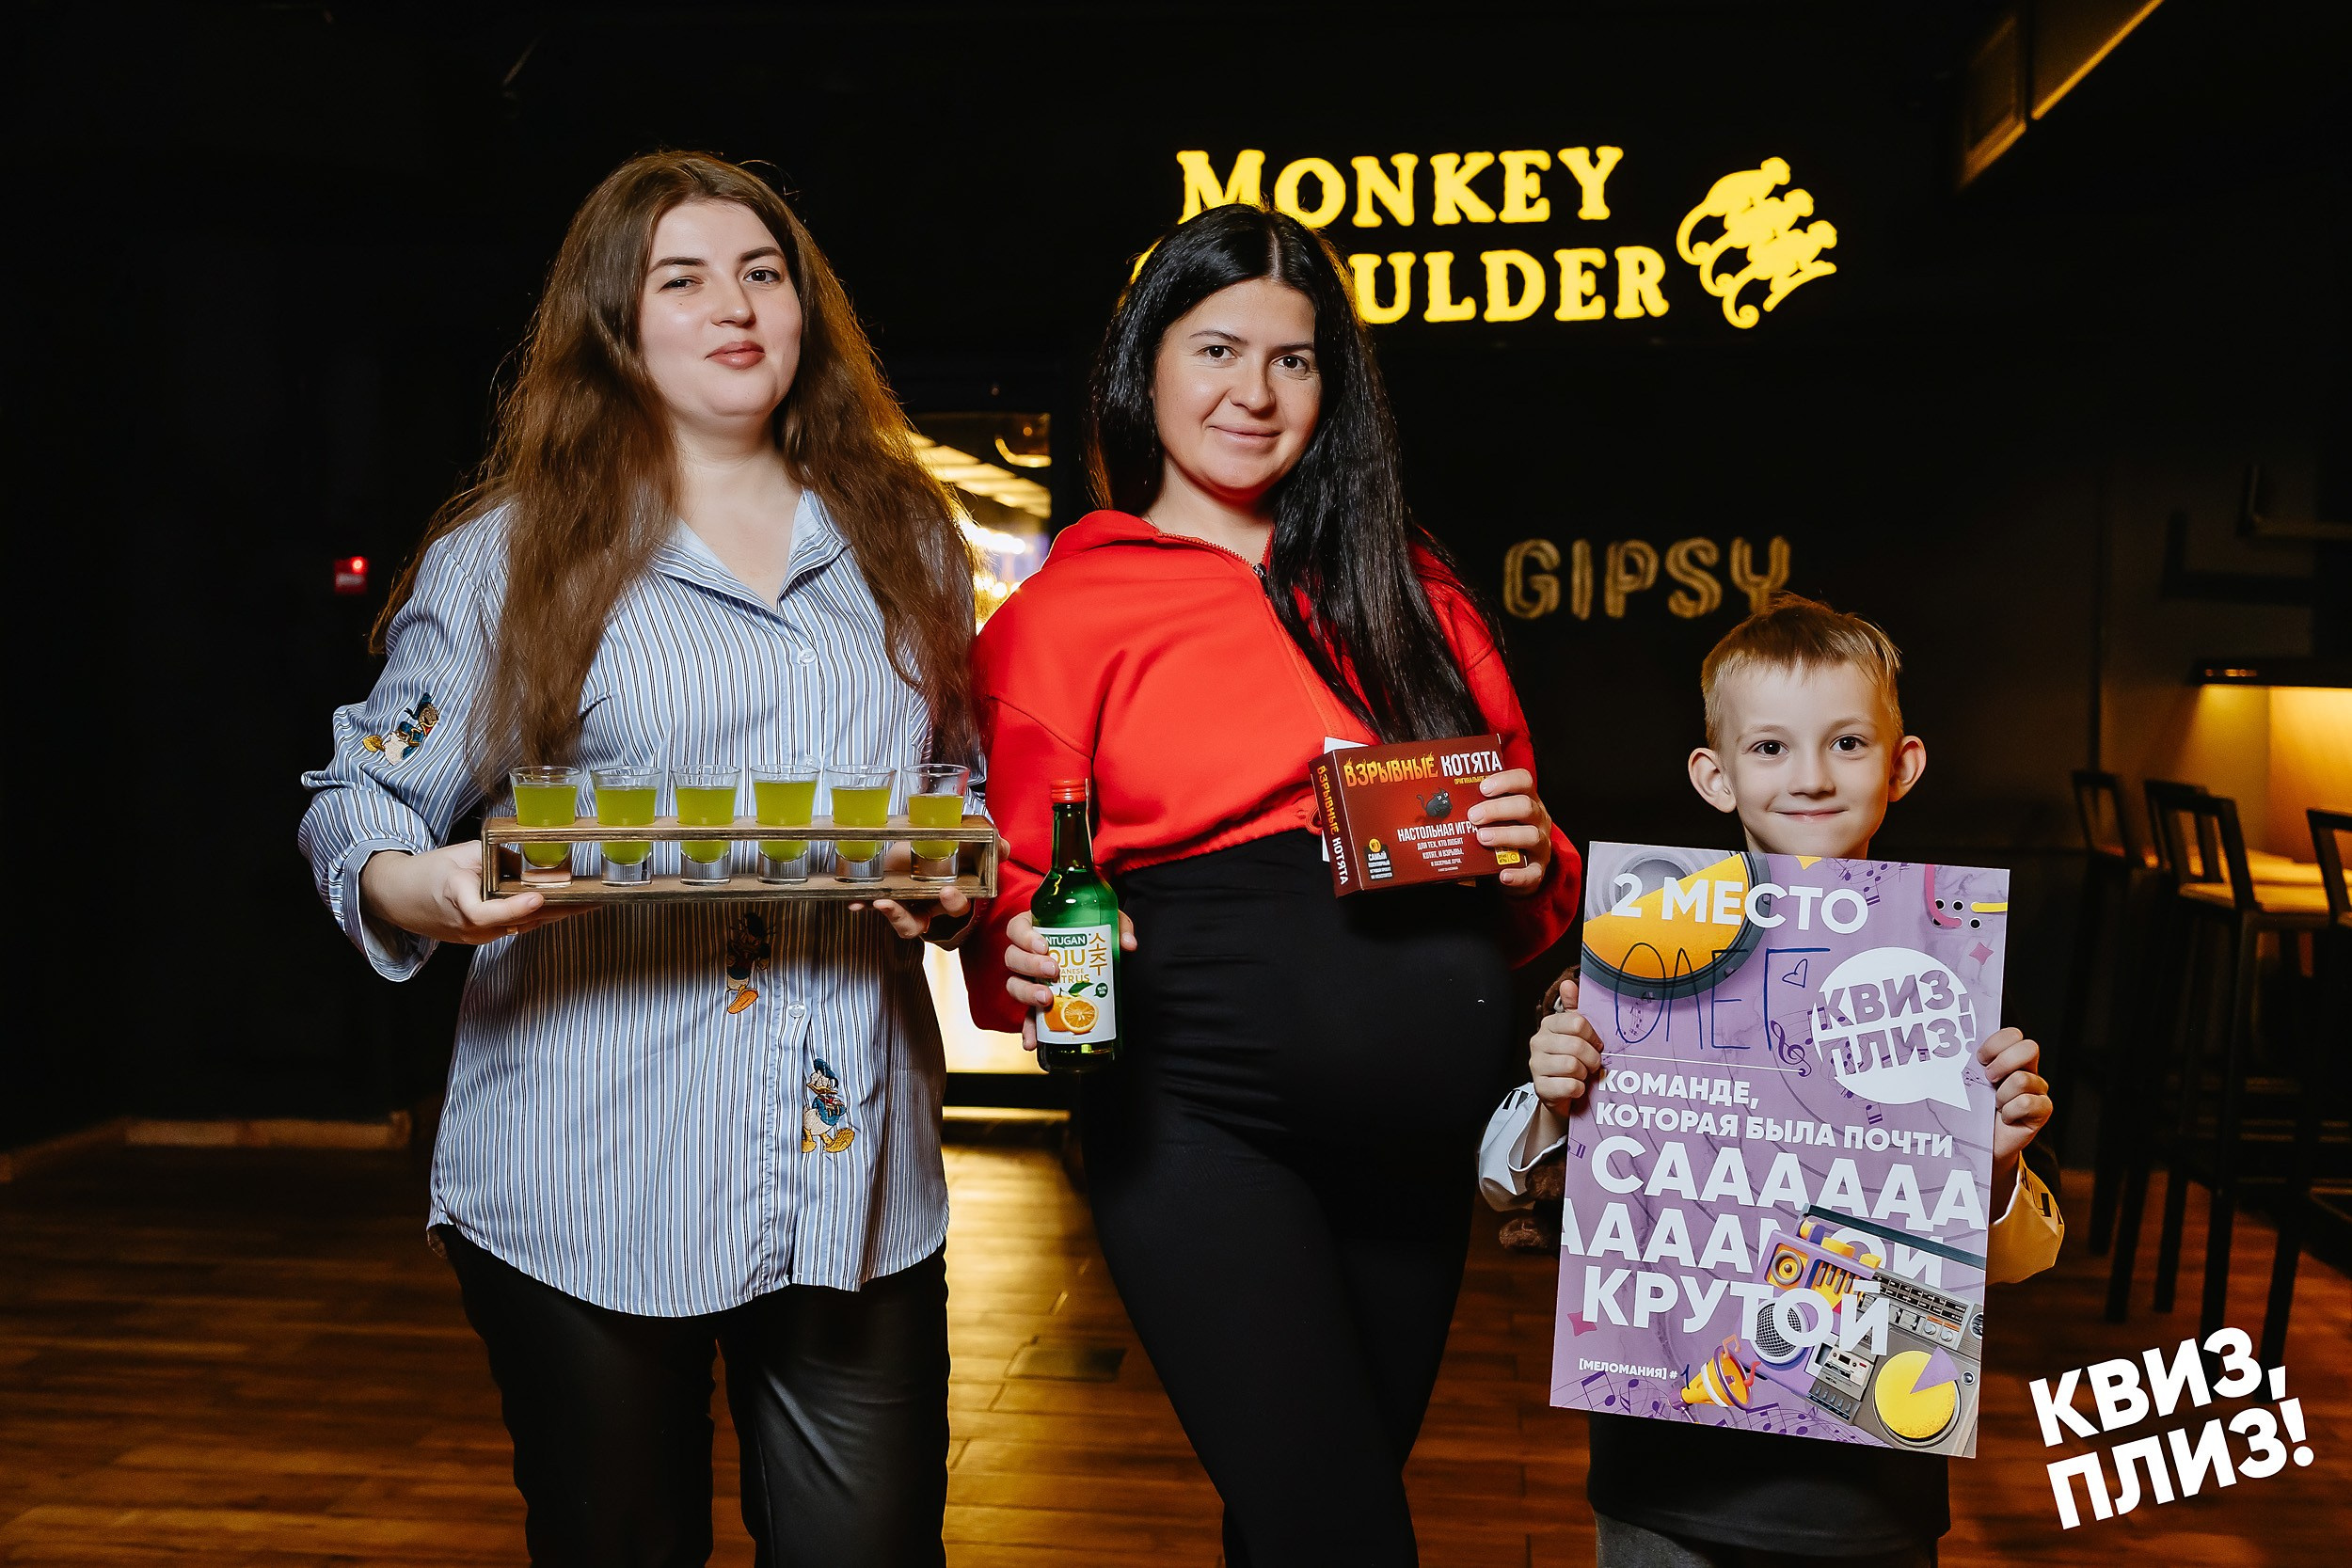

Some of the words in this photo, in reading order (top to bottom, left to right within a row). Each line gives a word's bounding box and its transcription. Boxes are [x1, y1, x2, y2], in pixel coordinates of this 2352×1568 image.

[1176, 145, 1624, 228] MONKEY
[1128, 243, 1670, 325] ULDER
[1504, 535, 1792, 620] GIPSY
[1343, 752, 1438, 787] ВЗРЫВНЫЕ
[1440, 751, 1503, 777] КОТЯТА
[1317, 765, 1340, 835] ВЗРЫВНЫЕ
[1331, 837, 1348, 885] КОТЯТА
[1397, 824, 1454, 842] НАСТОЛЬНАЯ
[1455, 821, 1478, 835] ИГРА
[1612, 873, 1643, 918] 2
[1661, 877, 1869, 934] МЕСТО
[1045, 935, 1086, 945] NTUGAN
[1048, 948, 1086, 968] OJU
[1057, 974, 1090, 984] ITRUS
[1599, 1069, 1760, 1110] КОМАНДЕ,
[1596, 1101, 1739, 1138] КОТОРАЯ
[1745, 1115, 1836, 1145] БЫЛА
[1844, 1123, 1953, 1159] ПОЧТИ
[1591, 1134, 1988, 1230] САААААА
[1582, 1264, 1890, 1356] КРУТОЙ
[1579, 1357, 1667, 1380] [МЕЛОМАНИЯ]
